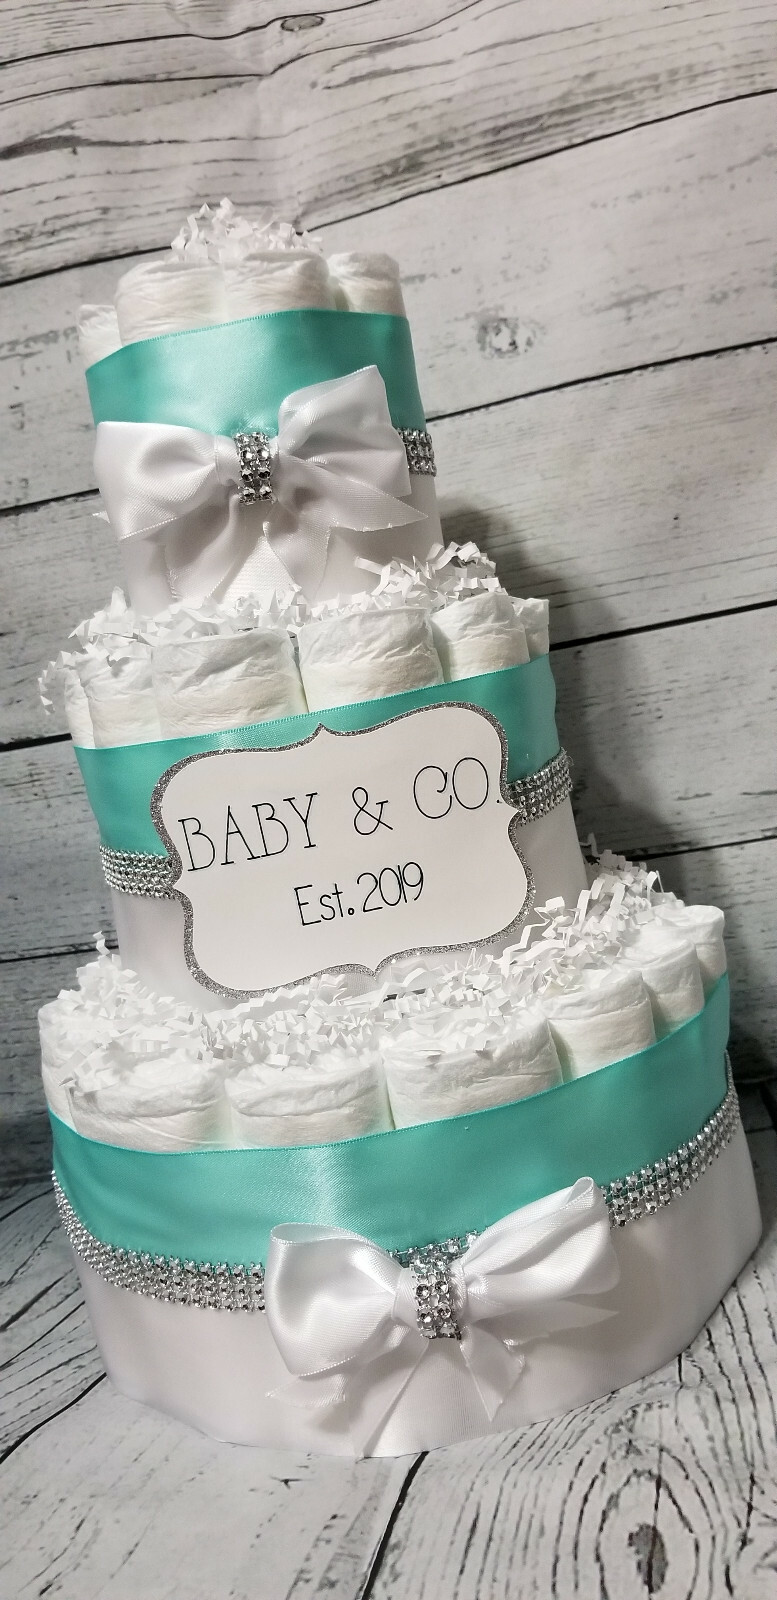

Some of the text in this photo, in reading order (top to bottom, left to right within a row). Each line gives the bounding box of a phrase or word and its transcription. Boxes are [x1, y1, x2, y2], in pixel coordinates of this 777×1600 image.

[177, 756, 503, 872] BABY & CO.
